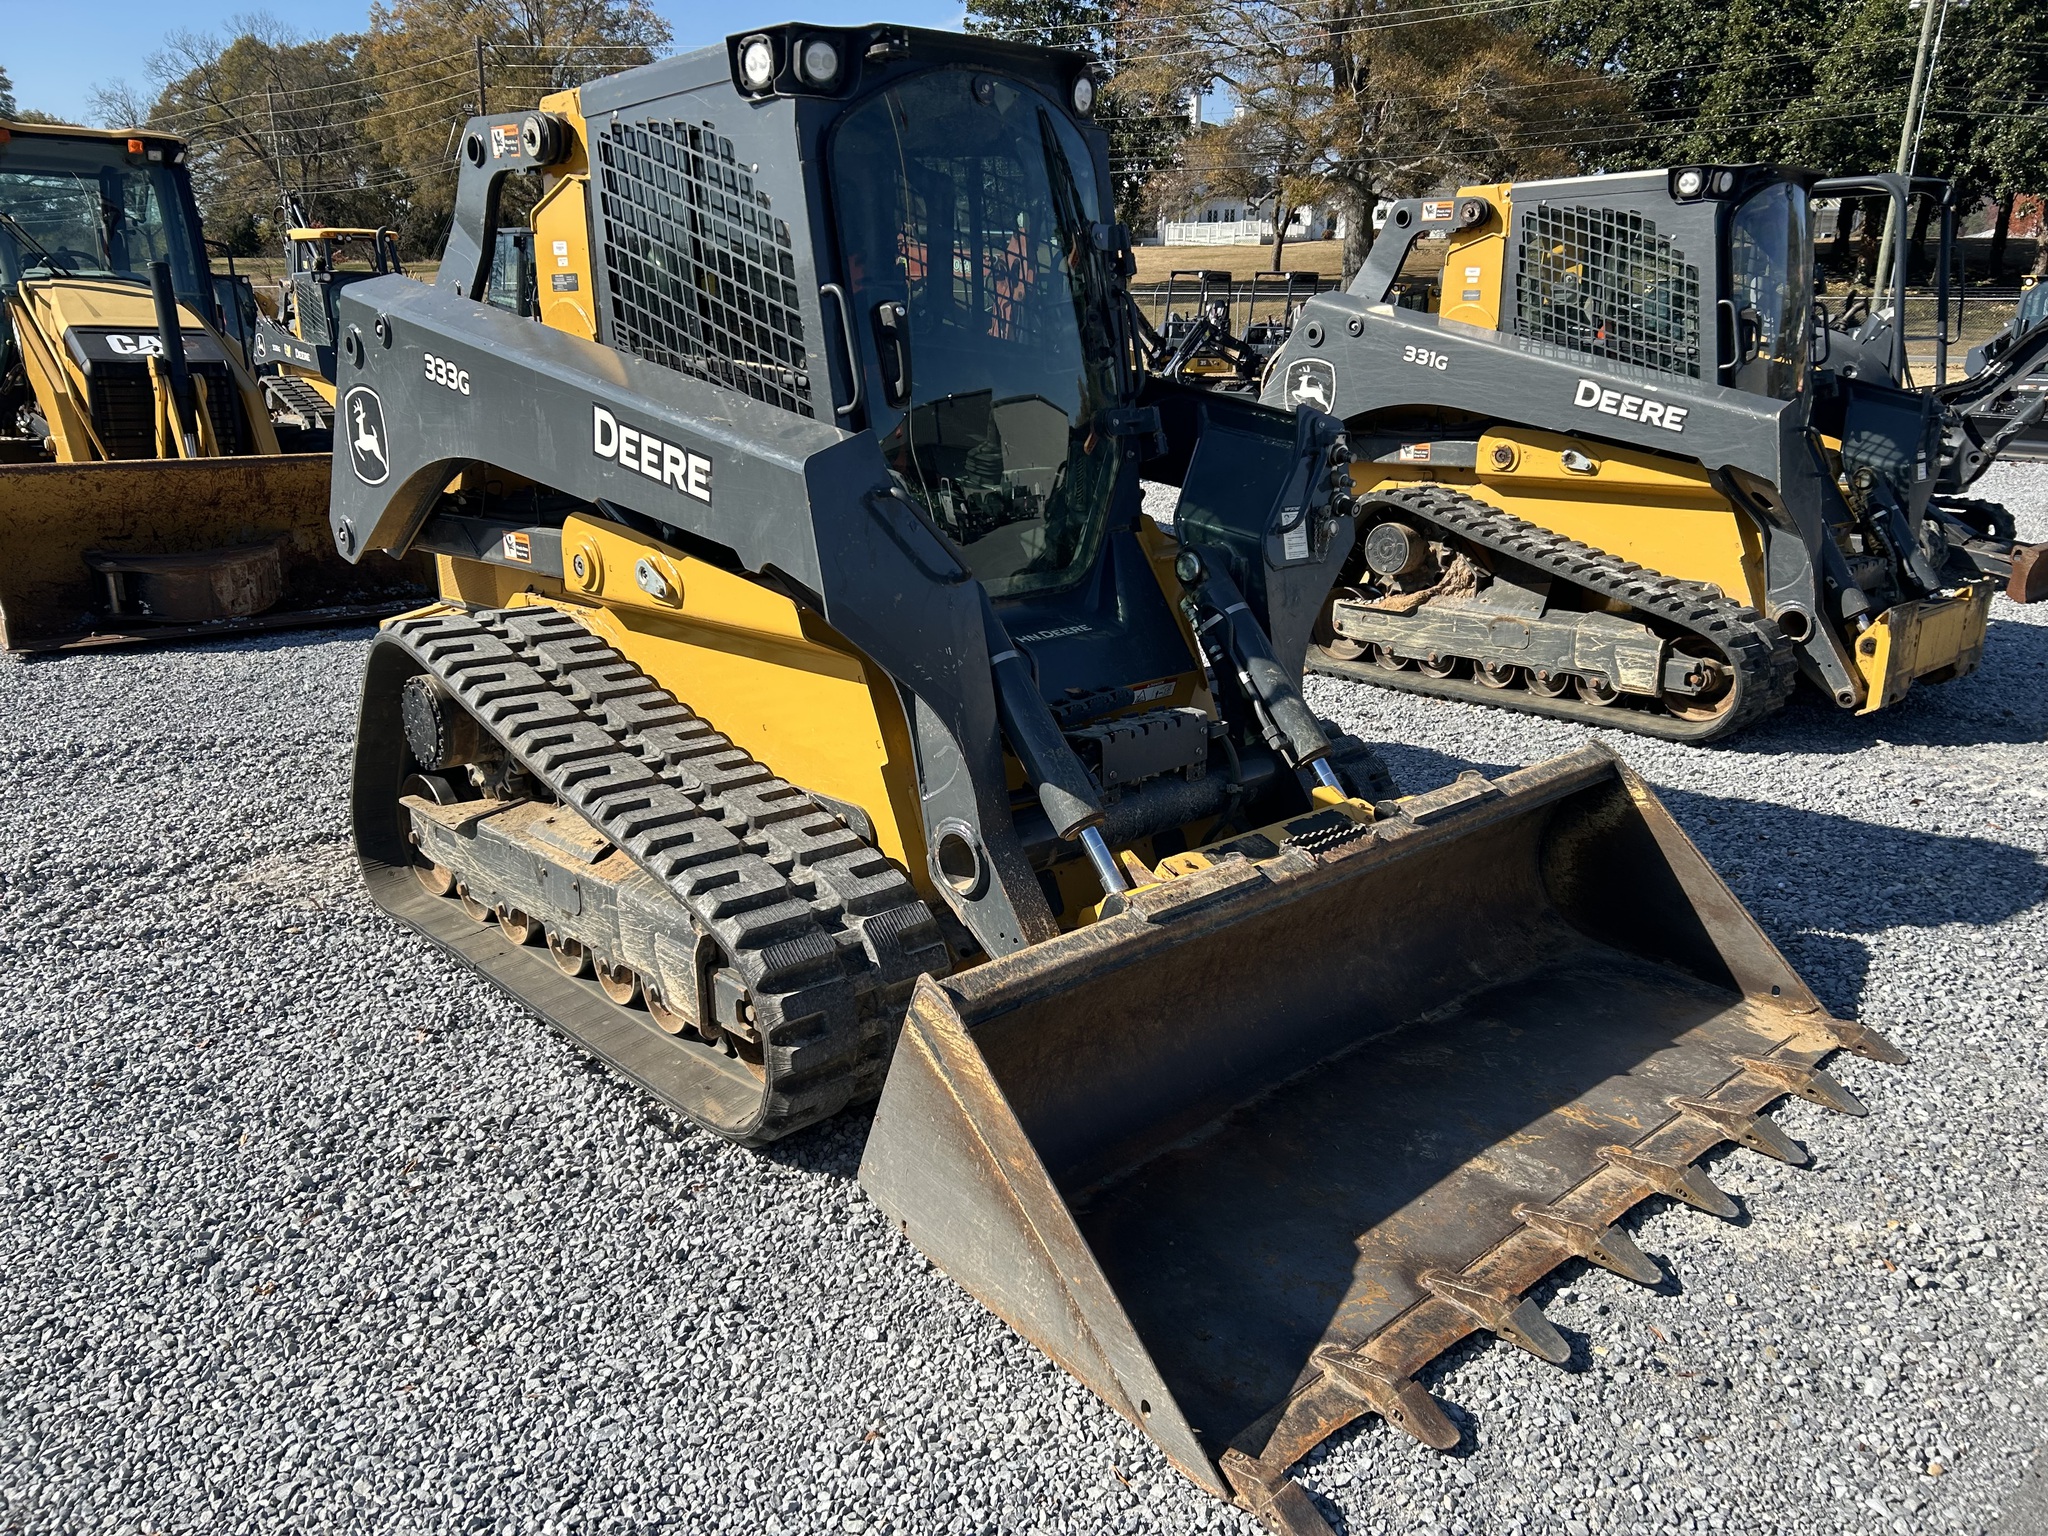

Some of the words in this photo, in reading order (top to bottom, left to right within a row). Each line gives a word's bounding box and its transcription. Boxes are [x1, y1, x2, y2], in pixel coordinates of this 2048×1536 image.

[424, 353, 470, 396] 333G
[1402, 345, 1449, 371] 331G
[1573, 379, 1689, 432] DEERE
[593, 404, 712, 503] DEERE
[1037, 624, 1093, 639] DEERE
